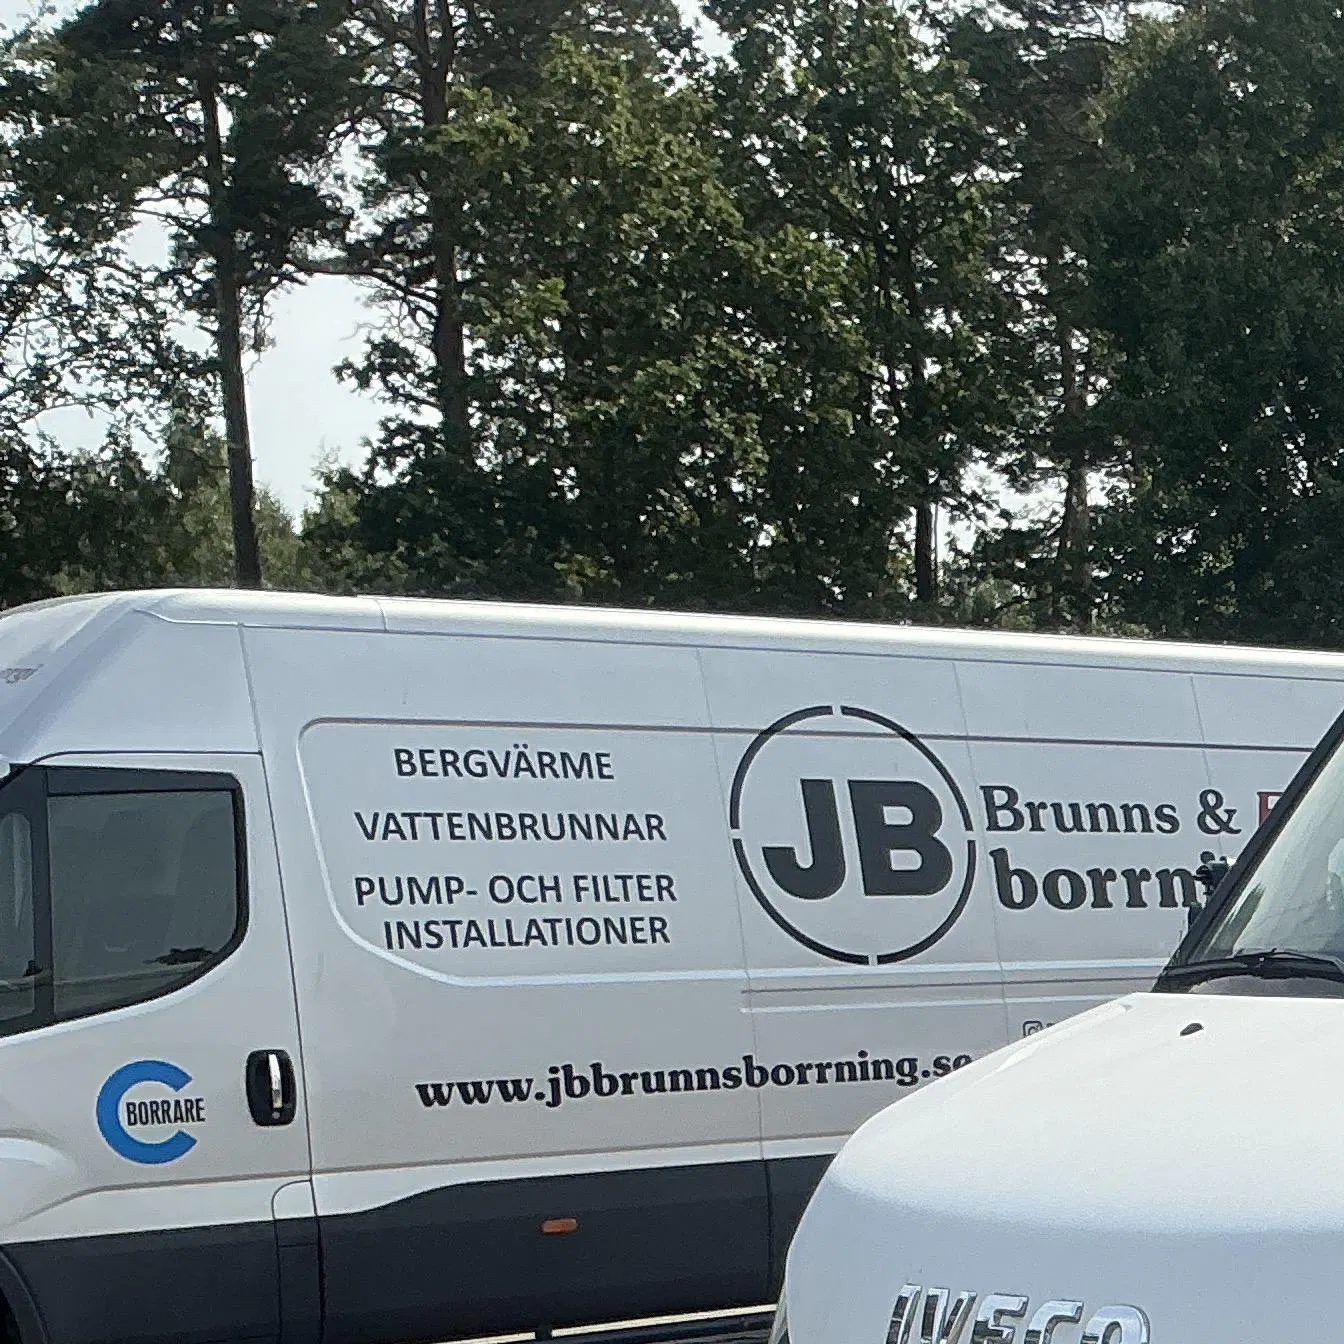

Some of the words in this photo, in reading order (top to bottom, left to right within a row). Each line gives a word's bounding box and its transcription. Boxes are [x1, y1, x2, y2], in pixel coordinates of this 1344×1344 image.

[393, 743, 615, 781] BERGVÄRME
[354, 811, 668, 842] VATTENBRUNNAR
[979, 784, 1181, 834] Brunns
[1197, 788, 1242, 836] &
[761, 777, 953, 901] JB
[355, 875, 478, 907] PUMP-
[488, 874, 562, 904] OCH
[573, 874, 678, 904] FILTER
[383, 916, 671, 950] INSTALLATIONER
[415, 1049, 973, 1108] www.jbbrunnsborrning.se
[125, 1098, 207, 1127] BORRARE
